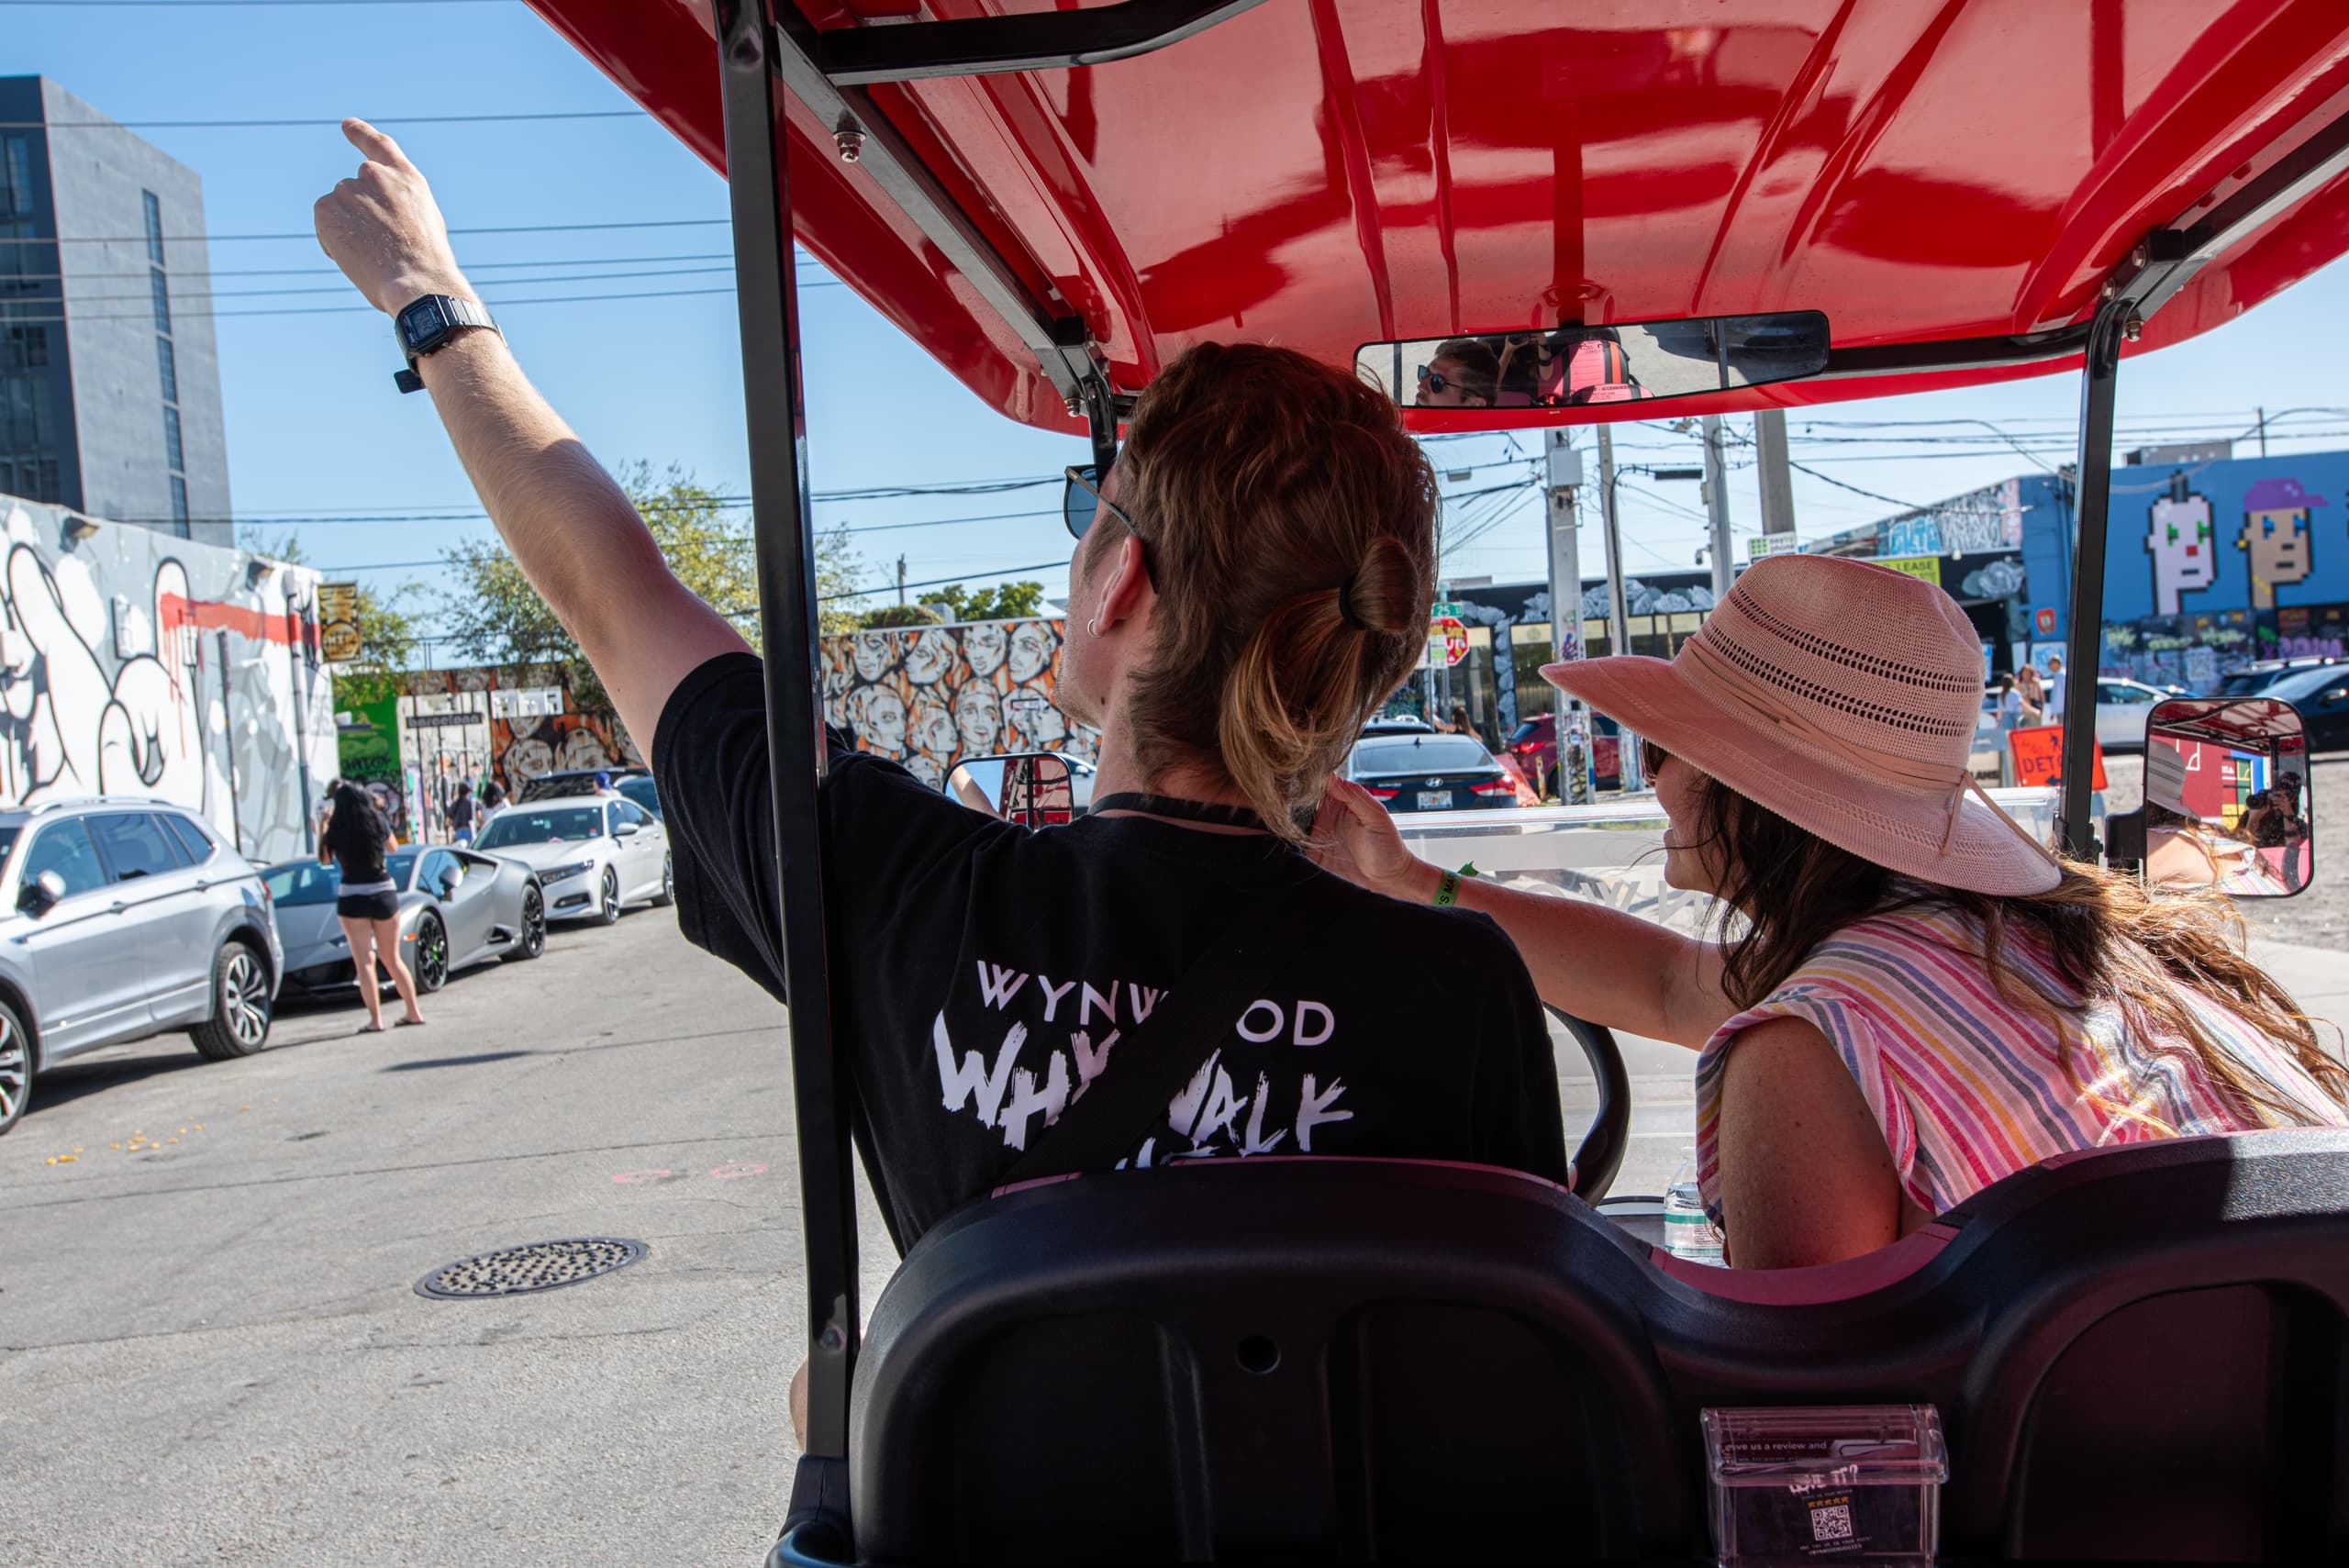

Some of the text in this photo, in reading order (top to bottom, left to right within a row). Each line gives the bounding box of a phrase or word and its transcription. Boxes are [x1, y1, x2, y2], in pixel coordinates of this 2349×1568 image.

[1438, 606, 1451, 617] 25
[407, 714, 480, 728] barcelona
[977, 960, 1335, 1046] WYNWOD
[1772, 1440, 1806, 1451] review
[1808, 1440, 1827, 1450] and
